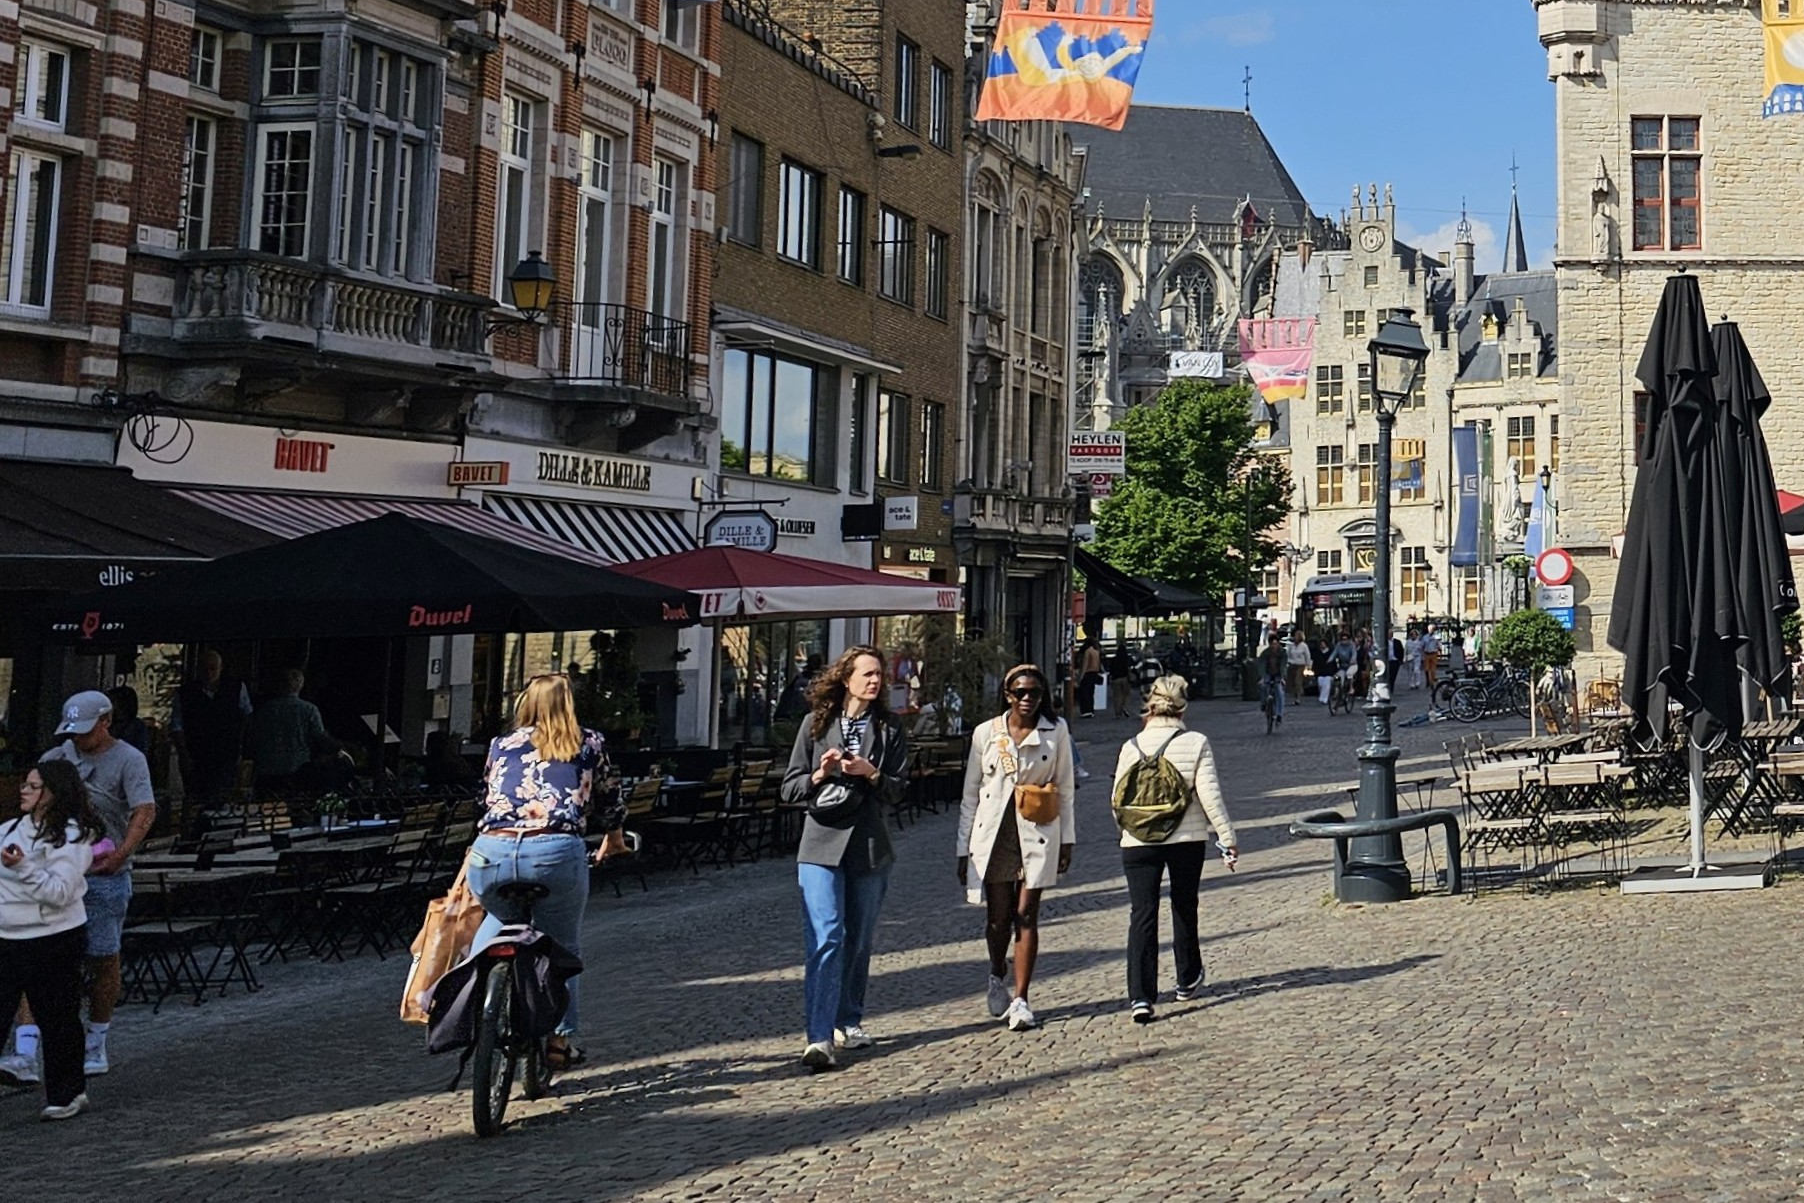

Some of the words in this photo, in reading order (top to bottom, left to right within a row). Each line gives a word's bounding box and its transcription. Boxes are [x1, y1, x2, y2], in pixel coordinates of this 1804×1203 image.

[1071, 434, 1121, 445] HEYLEN
[274, 438, 330, 473] BAVET
[453, 465, 493, 482] BAVET
[539, 452, 579, 484] DILLE
[580, 457, 593, 486] &
[594, 459, 651, 491] KAMILLE
[888, 506, 903, 514] ace
[719, 525, 752, 537] DILLE
[755, 525, 764, 535] &
[715, 536, 767, 546] AMILLE
[99, 565, 134, 586] ellis
[408, 604, 472, 627] Duvel
[662, 602, 689, 621] Duvel
